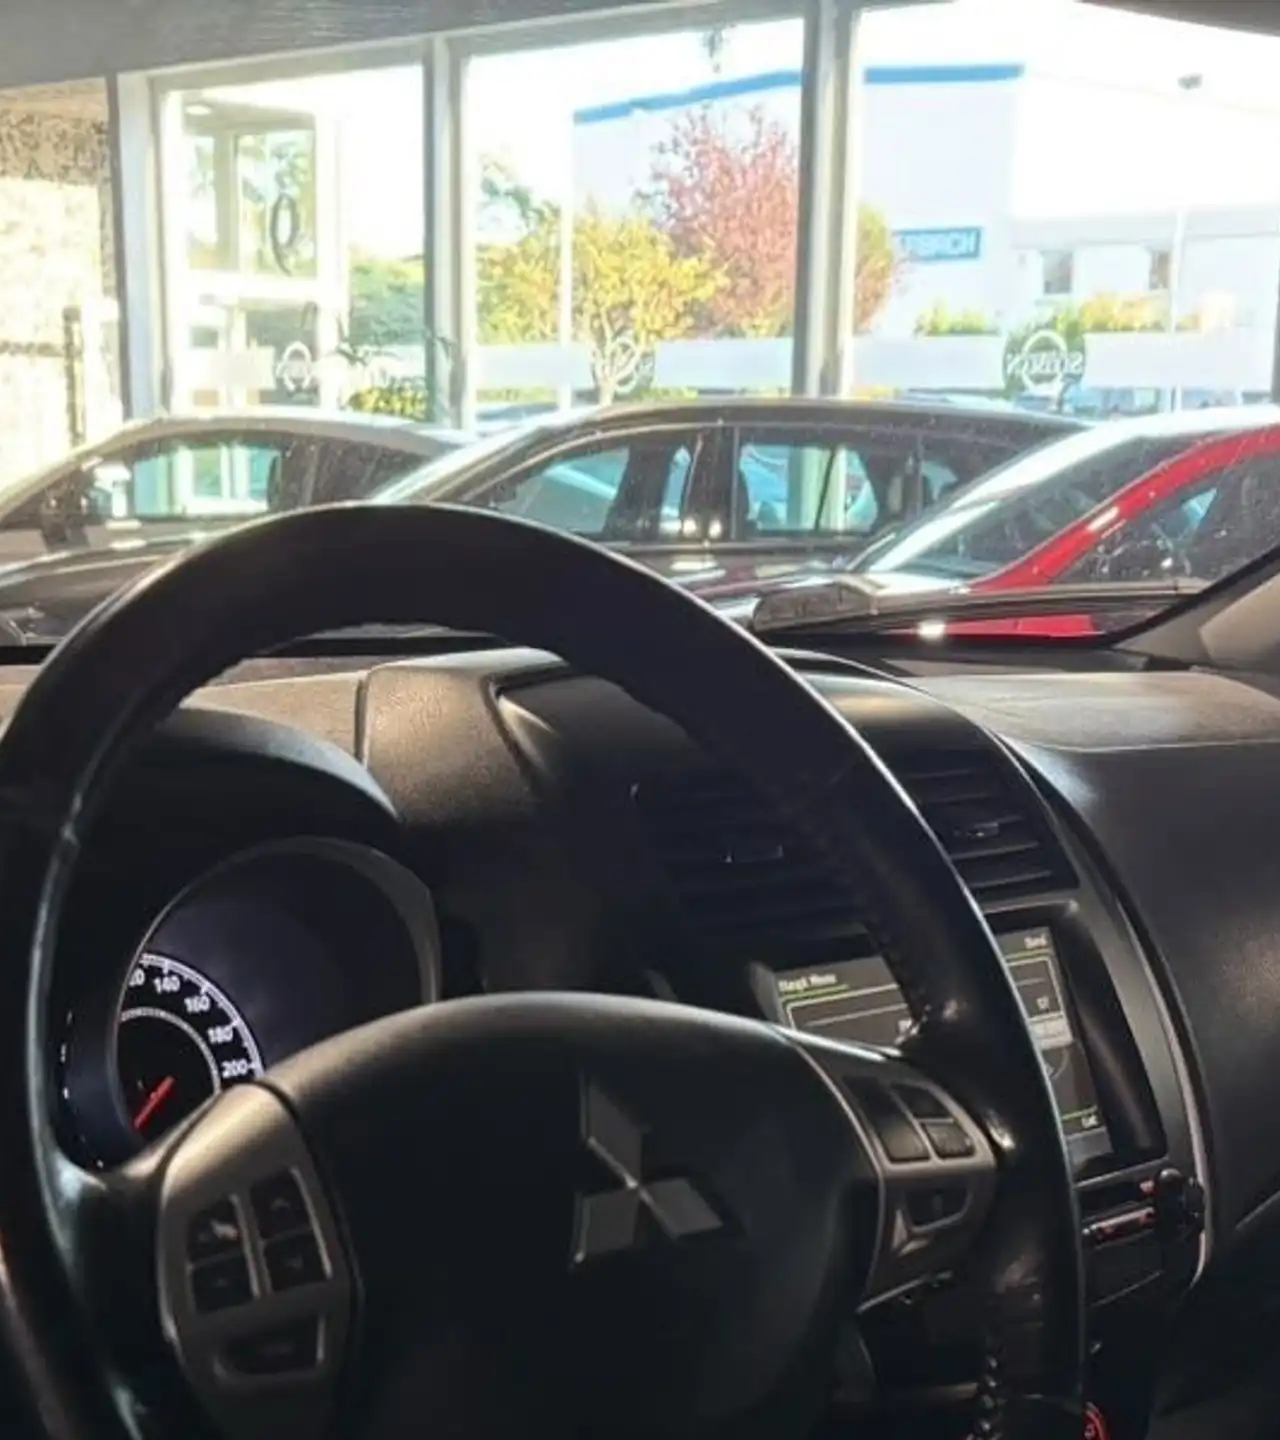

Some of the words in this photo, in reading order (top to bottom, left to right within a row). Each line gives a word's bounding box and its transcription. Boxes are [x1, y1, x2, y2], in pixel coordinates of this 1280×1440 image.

[153, 974, 181, 994] 140
[184, 994, 211, 1014] 160
[207, 1022, 234, 1044] 180
[222, 1059, 248, 1079] 200
